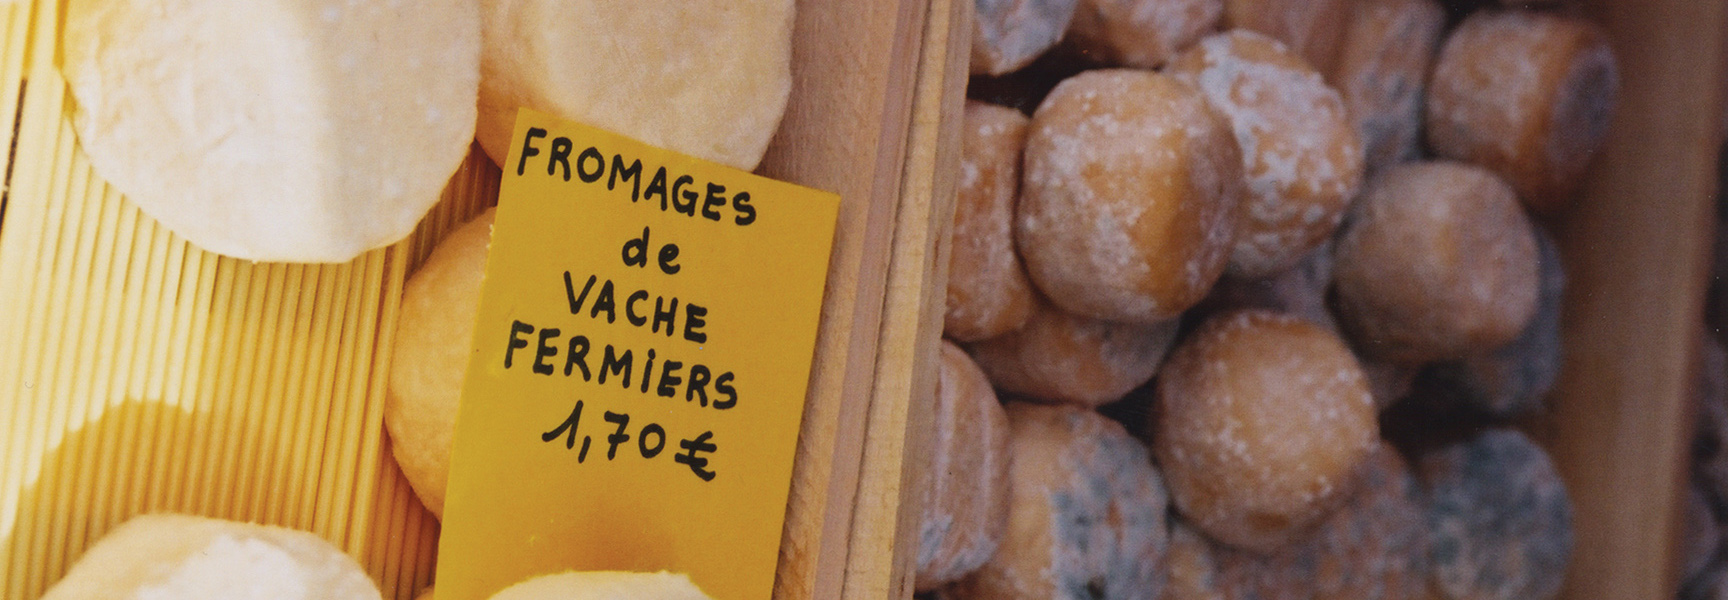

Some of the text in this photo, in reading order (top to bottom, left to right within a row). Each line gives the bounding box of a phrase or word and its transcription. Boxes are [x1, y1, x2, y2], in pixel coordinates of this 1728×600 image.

[517, 127, 757, 226] FROMAGES
[622, 227, 681, 275] de
[563, 270, 708, 344] VACHE
